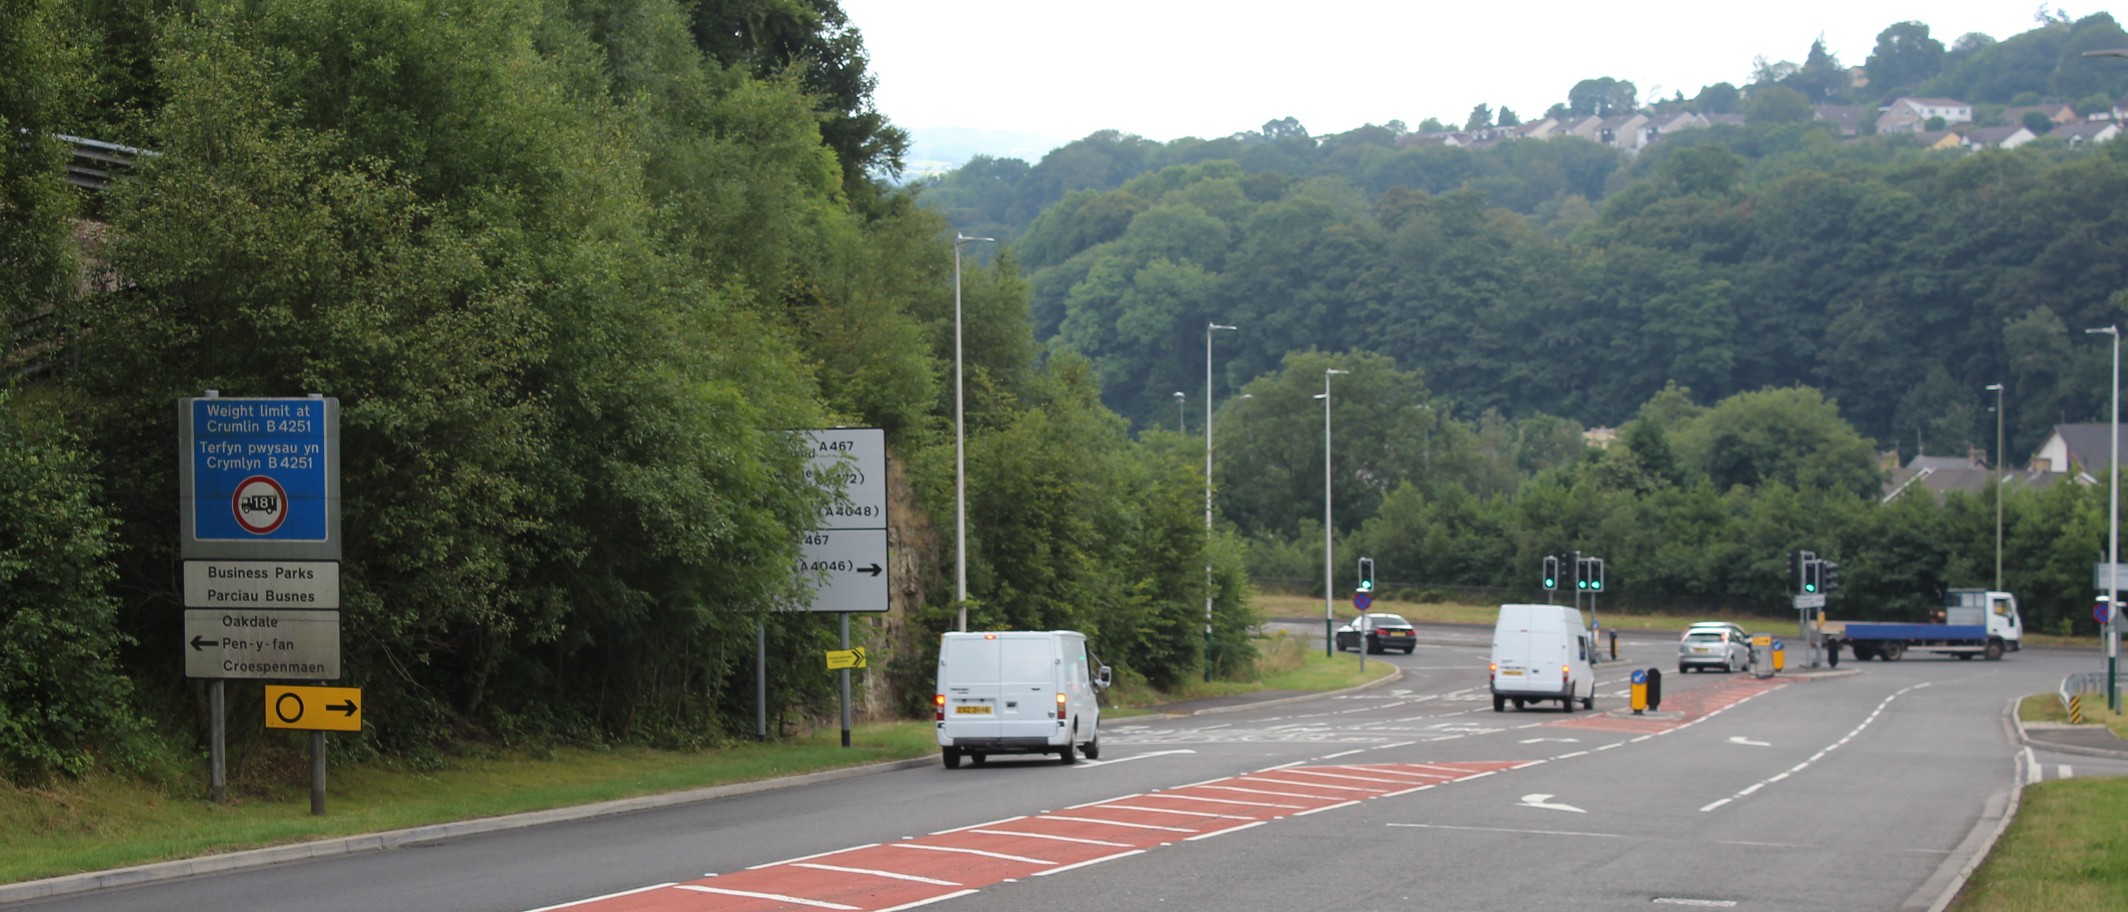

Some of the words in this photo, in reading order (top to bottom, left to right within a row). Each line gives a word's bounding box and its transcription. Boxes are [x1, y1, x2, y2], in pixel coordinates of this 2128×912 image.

[207, 404, 254, 419] Weight
[260, 404, 290, 417] limit
[296, 405, 310, 417] at
[207, 420, 259, 432] Crumlin
[200, 441, 242, 456] Terfyn
[248, 444, 298, 456] pwysau
[304, 444, 319, 455] yn
[819, 441, 854, 452] A467
[207, 456, 261, 471] Crymlyn
[208, 566, 268, 579] Business
[275, 567, 314, 579] Parks
[208, 589, 258, 601] Parciau
[265, 590, 315, 602] Busnes
[222, 615, 278, 627] Oakdale
[223, 660, 325, 674] Croespenmaen
